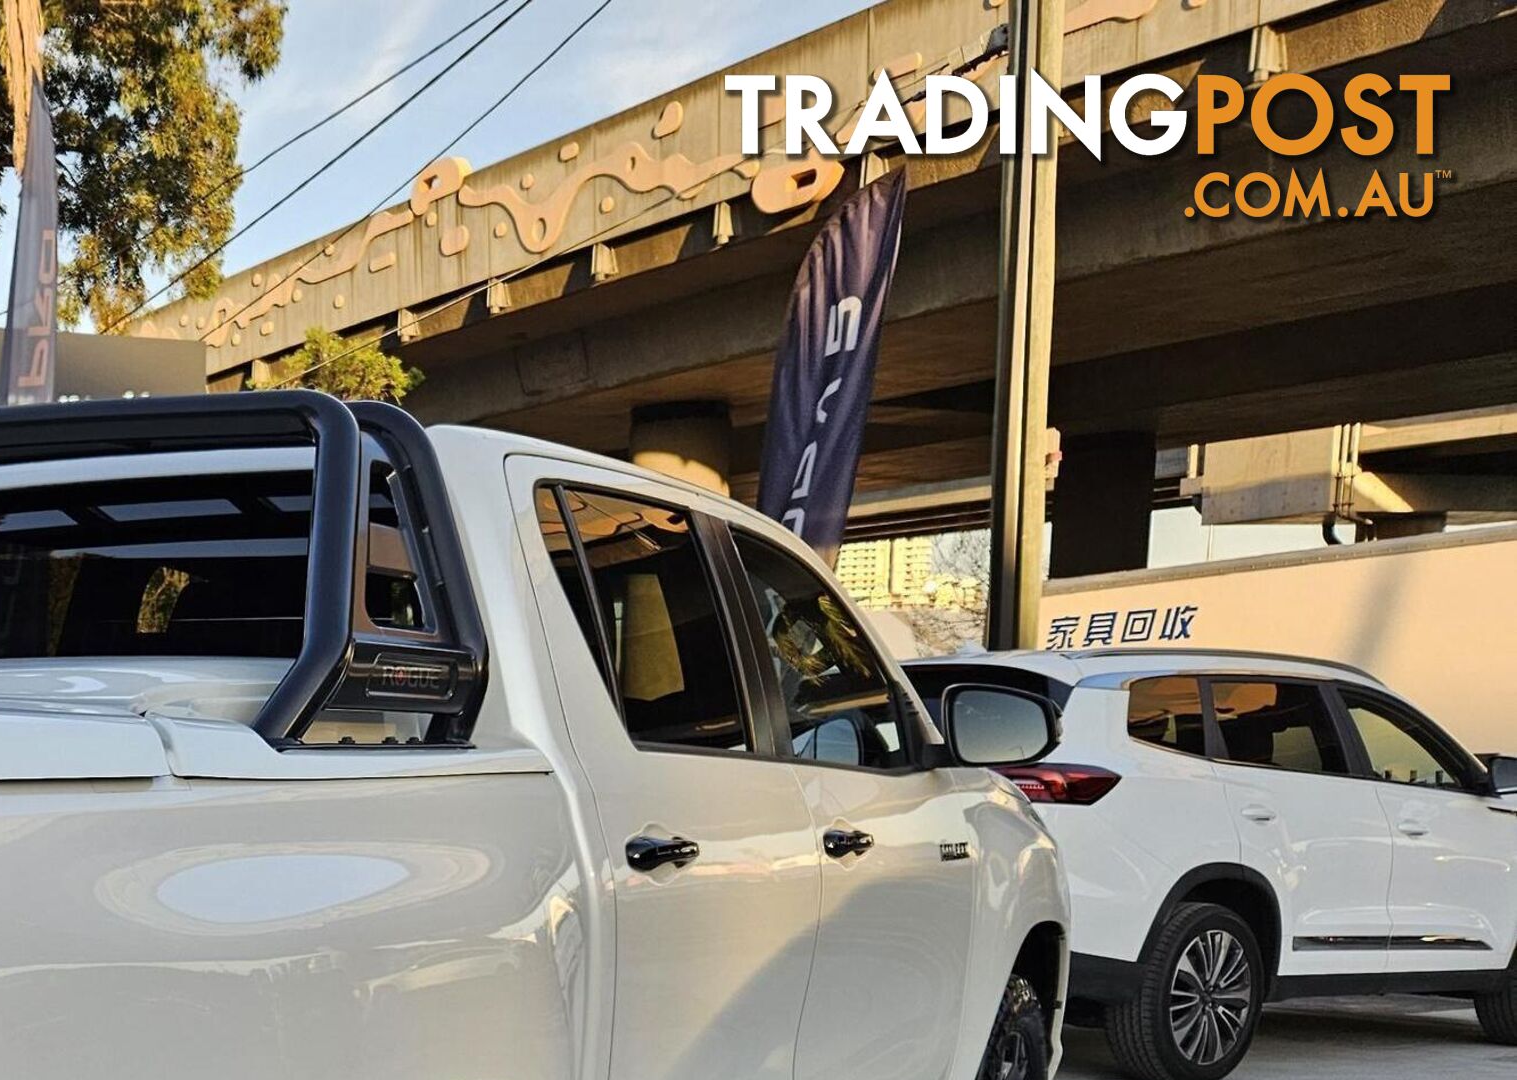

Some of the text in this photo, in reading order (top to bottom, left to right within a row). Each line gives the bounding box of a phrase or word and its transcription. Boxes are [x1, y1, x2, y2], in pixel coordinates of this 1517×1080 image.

[1046, 606, 1199, 650] 家具回收
[382, 665, 441, 689] ROGUE
